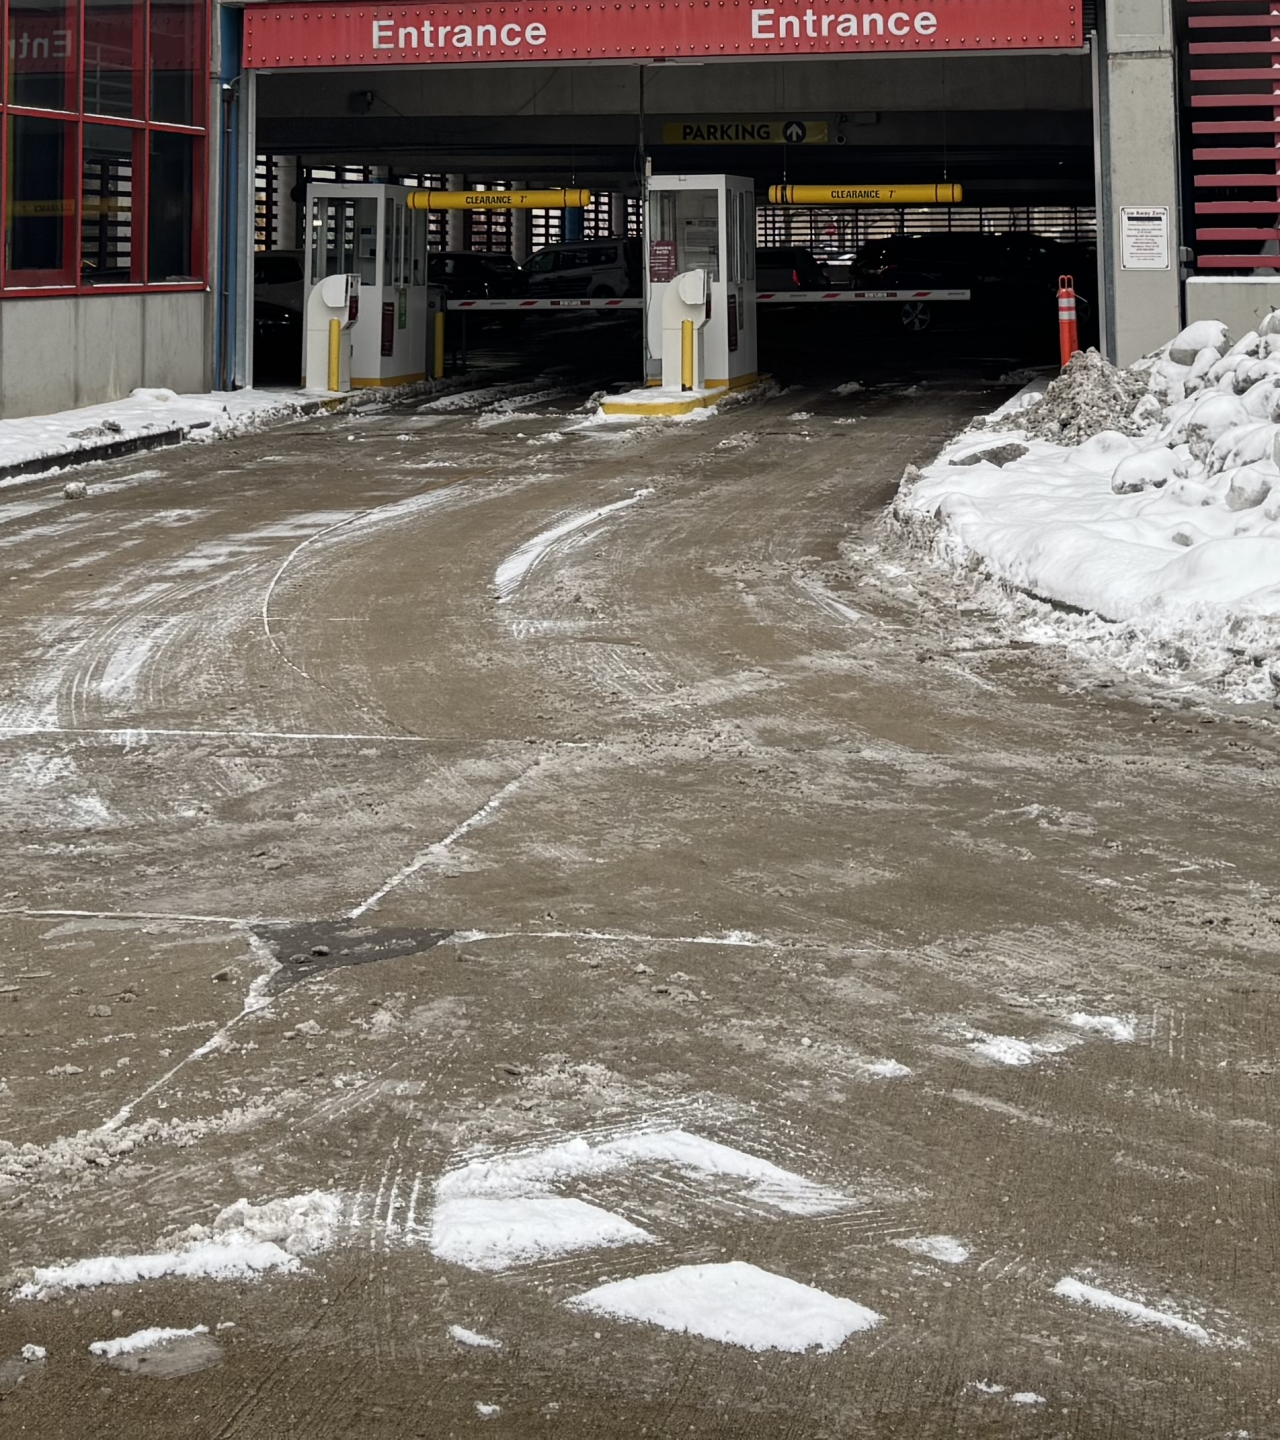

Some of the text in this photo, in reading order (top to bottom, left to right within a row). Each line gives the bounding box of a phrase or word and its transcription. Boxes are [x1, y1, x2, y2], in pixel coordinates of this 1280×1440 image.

[751, 8, 938, 39] Entrance
[372, 19, 547, 49] Entrance
[682, 124, 771, 141] PARKING
[465, 195, 512, 204] CLEARANCE
[831, 190, 880, 199] CLEARANCE
